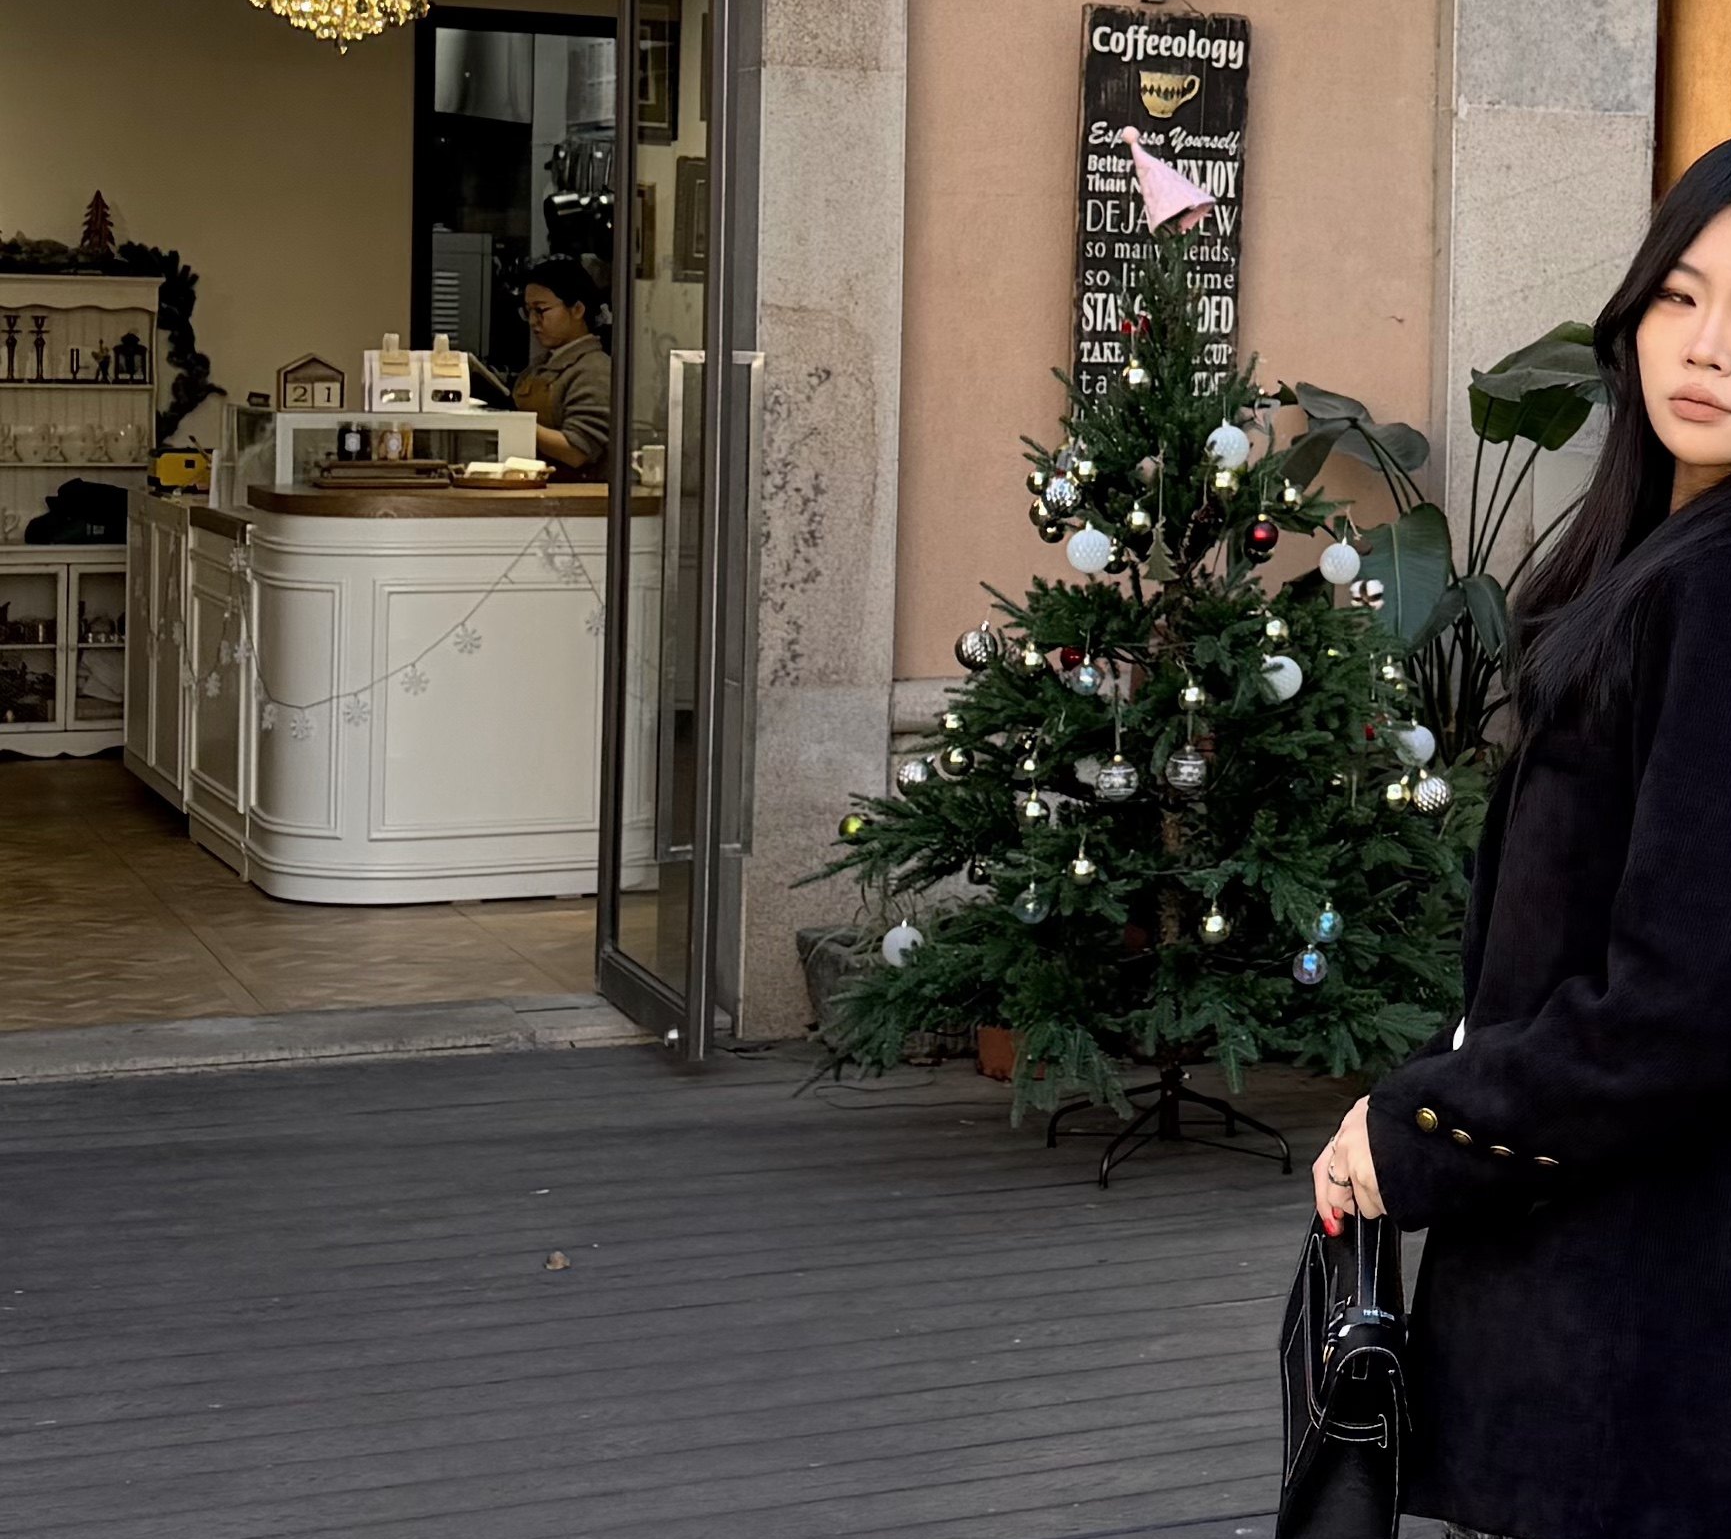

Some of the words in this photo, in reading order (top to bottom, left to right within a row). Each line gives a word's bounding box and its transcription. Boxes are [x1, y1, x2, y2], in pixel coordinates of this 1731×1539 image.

[1092, 25, 1245, 70] Coffeeology
[1088, 121, 1165, 149] Espsso
[1169, 126, 1240, 155] Yourself
[1087, 154, 1134, 172] Better
[1087, 173, 1127, 192] Than
[1085, 241, 1107, 259] so
[1114, 242, 1162, 264] many
[1084, 269, 1110, 287] so
[1187, 266, 1235, 290] time
[1079, 341, 1124, 363] TAKE
[1203, 343, 1233, 365] CUP
